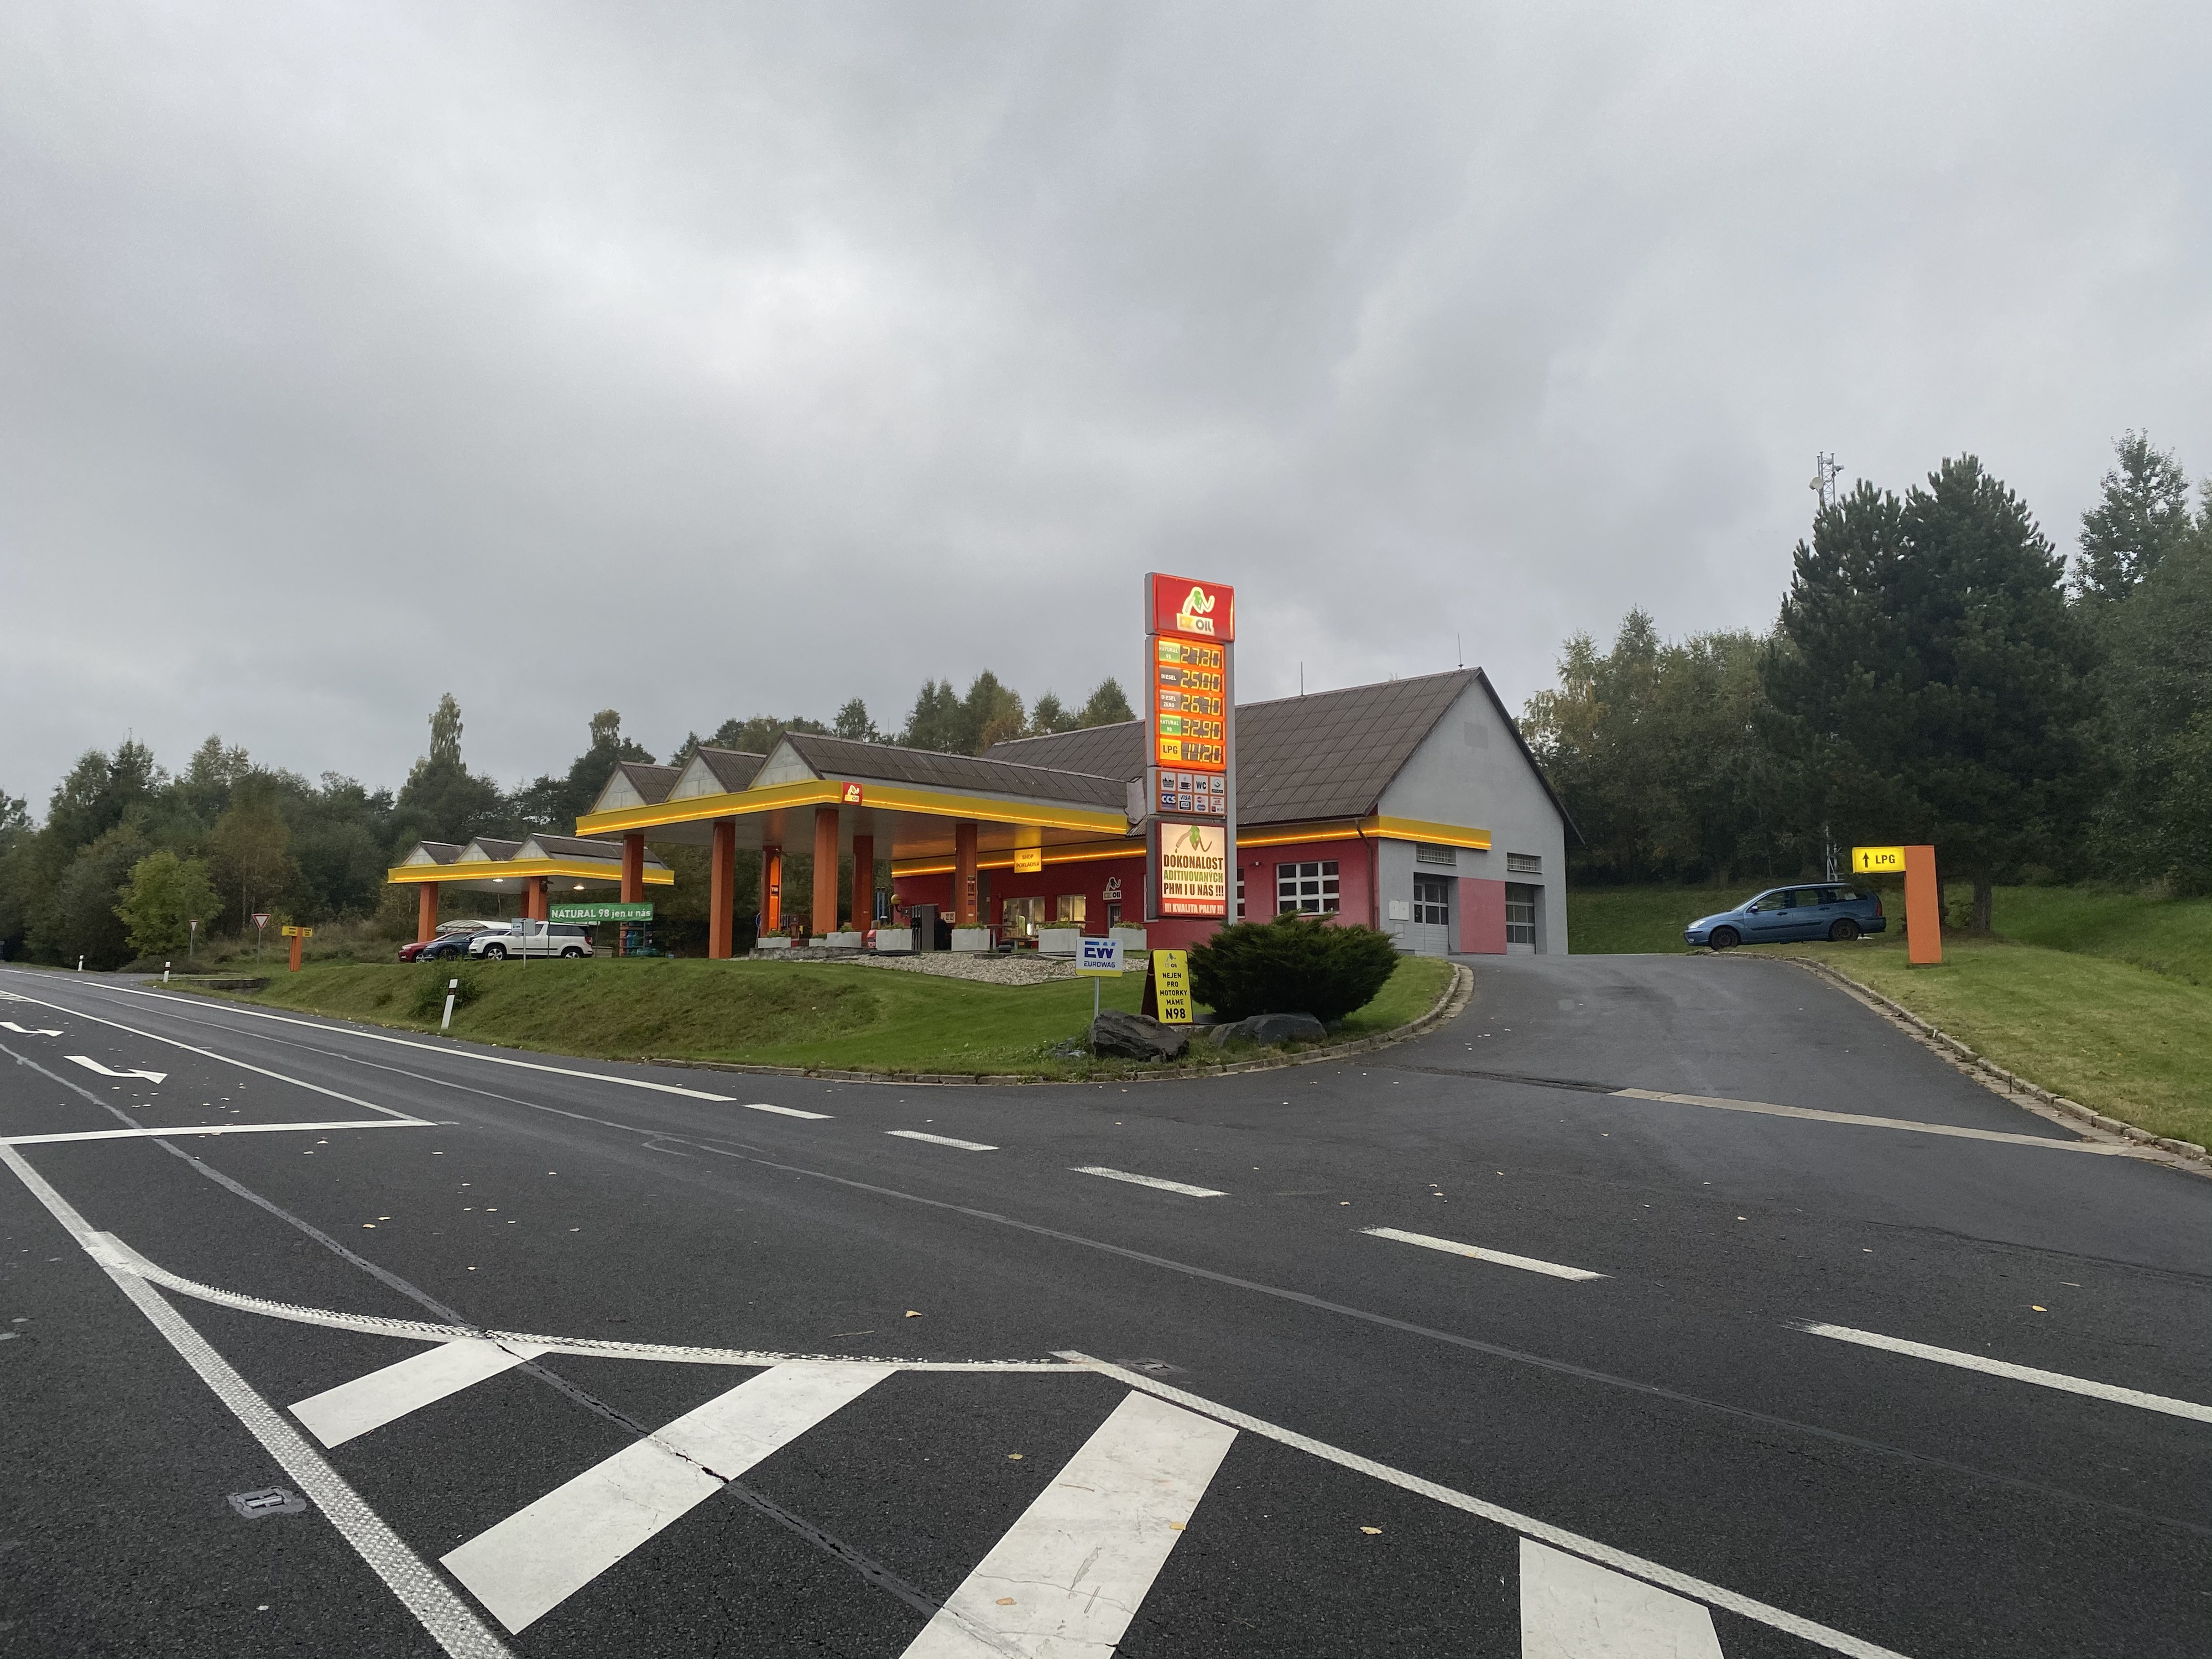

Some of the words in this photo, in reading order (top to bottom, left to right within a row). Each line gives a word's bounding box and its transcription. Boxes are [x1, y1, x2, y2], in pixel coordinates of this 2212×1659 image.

[1181, 669, 1220, 692] 25.00
[1181, 694, 1221, 716] 26.70
[1182, 718, 1221, 740] 32.90
[1162, 744, 1178, 754] LPG
[1196, 781, 1207, 790] WC
[1162, 795, 1176, 804] CCS
[1164, 854, 1223, 870] DOKONALOST
[1875, 854, 1896, 864] LPG
[1164, 869, 1223, 883] ADITIVOVANÝCH
[1164, 883, 1182, 895] PHM
[1185, 884, 1187, 895] I
[1190, 884, 1195, 895] U
[1197, 883, 1214, 896] NÁS
[1215, 885, 1224, 896] !!!
[551, 909, 596, 918] NATURAL
[598, 909, 609, 917] 98
[611, 910, 625, 919] jen
[635, 908, 651, 917] nás
[1172, 904, 1198, 914] KVALITA
[1199, 904, 1216, 914] PALIV
[1165, 1008, 1186, 1019] N98
